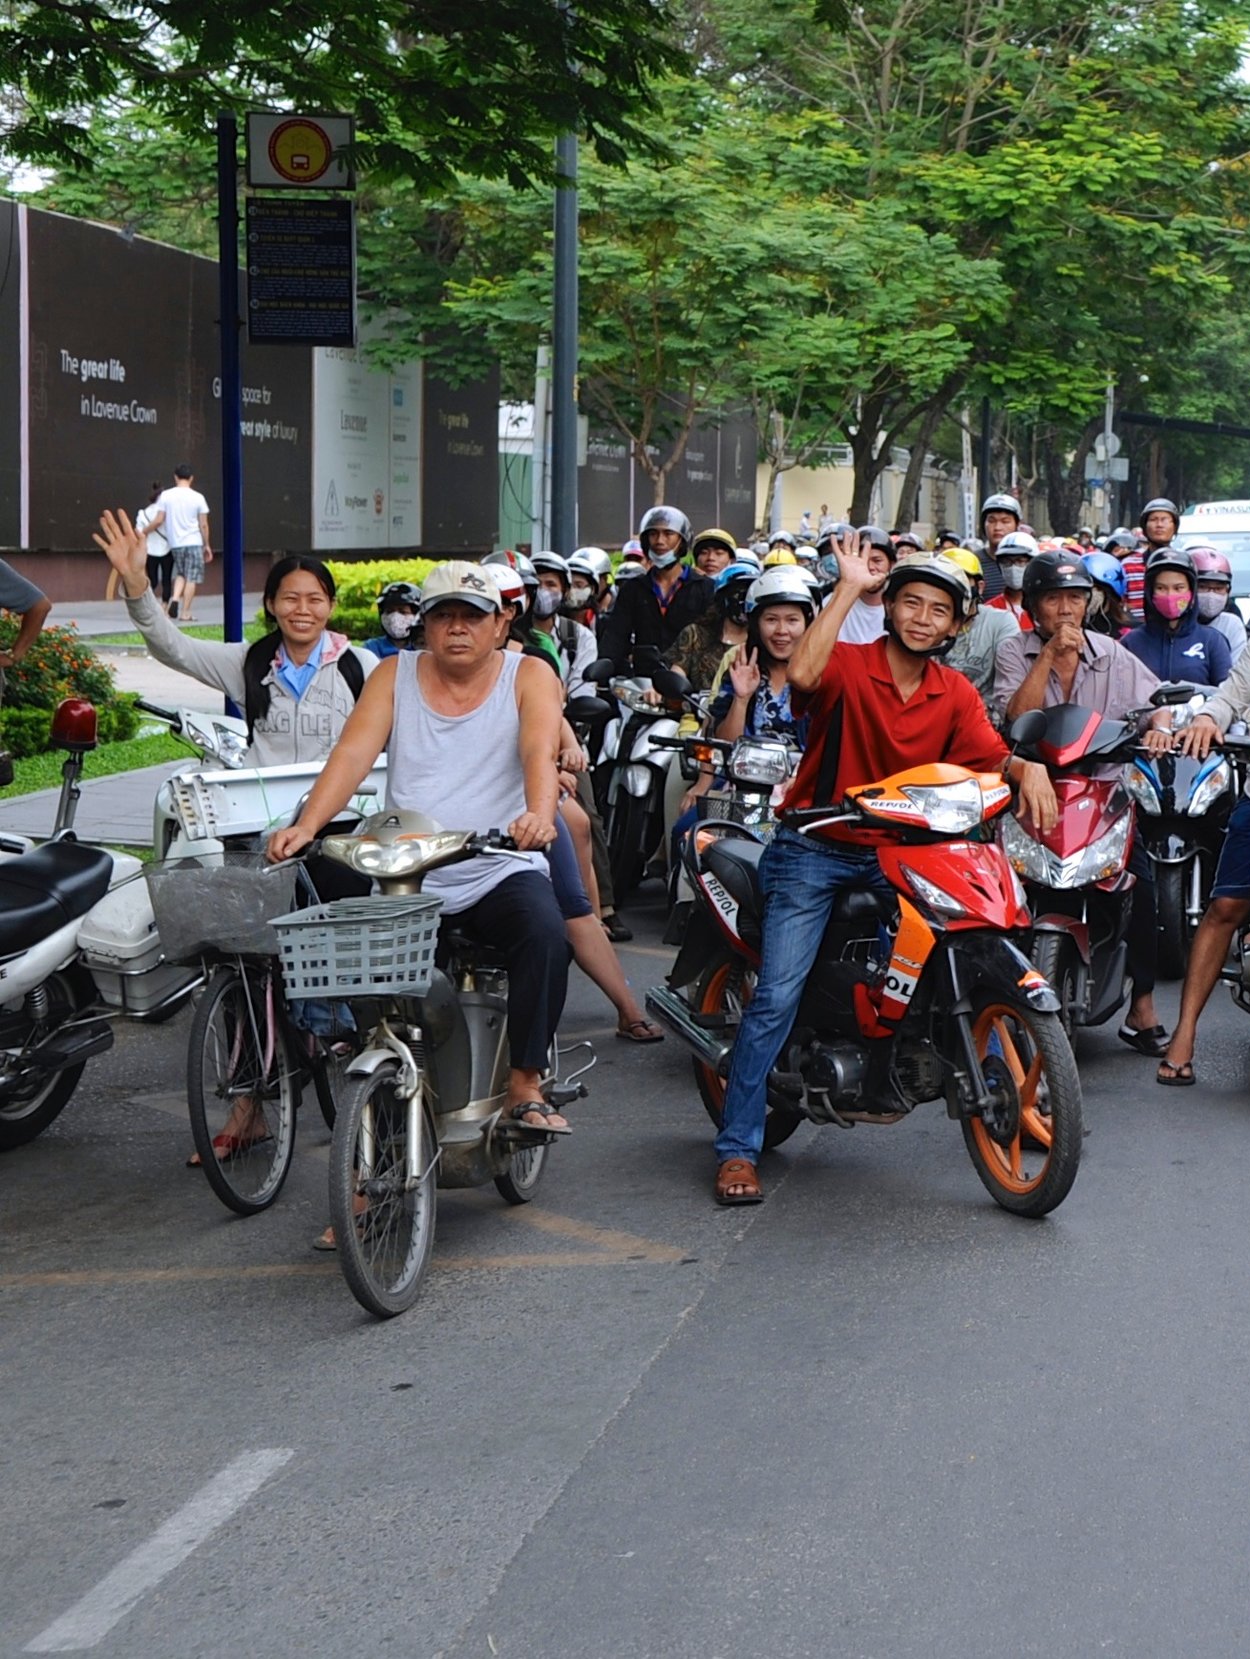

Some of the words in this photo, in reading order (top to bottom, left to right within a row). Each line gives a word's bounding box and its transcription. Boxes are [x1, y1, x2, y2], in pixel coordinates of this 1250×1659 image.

[61, 349, 79, 375] The
[81, 359, 108, 382] great
[109, 358, 125, 382] life
[81, 394, 89, 416] in
[130, 400, 157, 424] Crown
[870, 801, 914, 810] REPSOL
[705, 879, 737, 917] REPSOL
